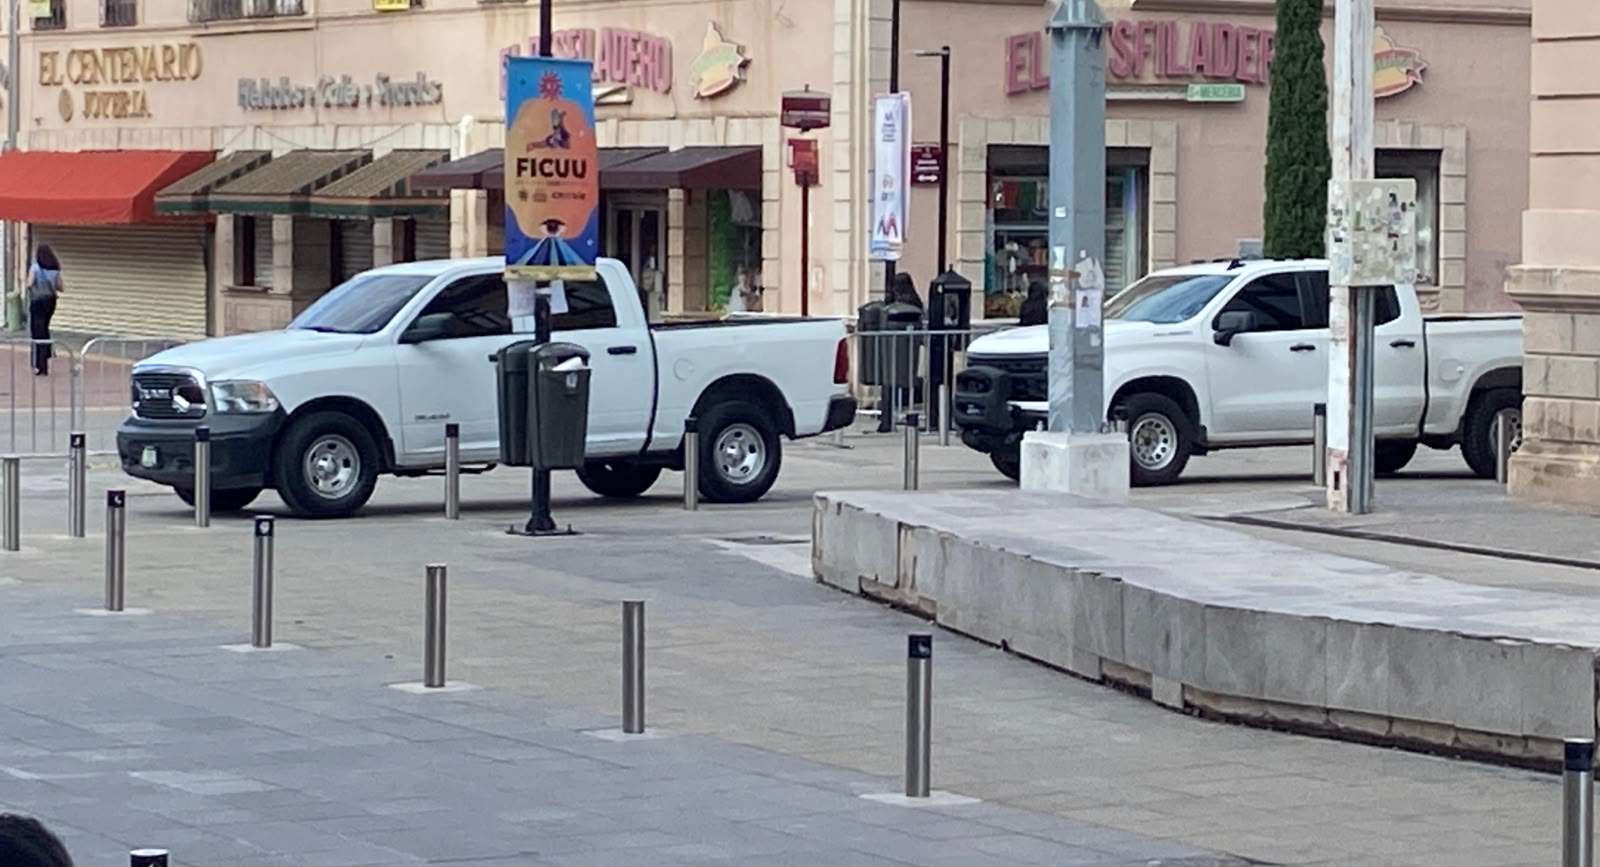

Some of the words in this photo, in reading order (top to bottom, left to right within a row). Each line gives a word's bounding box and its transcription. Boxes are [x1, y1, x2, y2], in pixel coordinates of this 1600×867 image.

[39, 51, 63, 86] EL
[67, 43, 203, 84] CENTENARIO
[1006, 31, 1049, 96] EL
[82, 90, 152, 119] JOYERIA
[517, 158, 587, 178] FICUU
